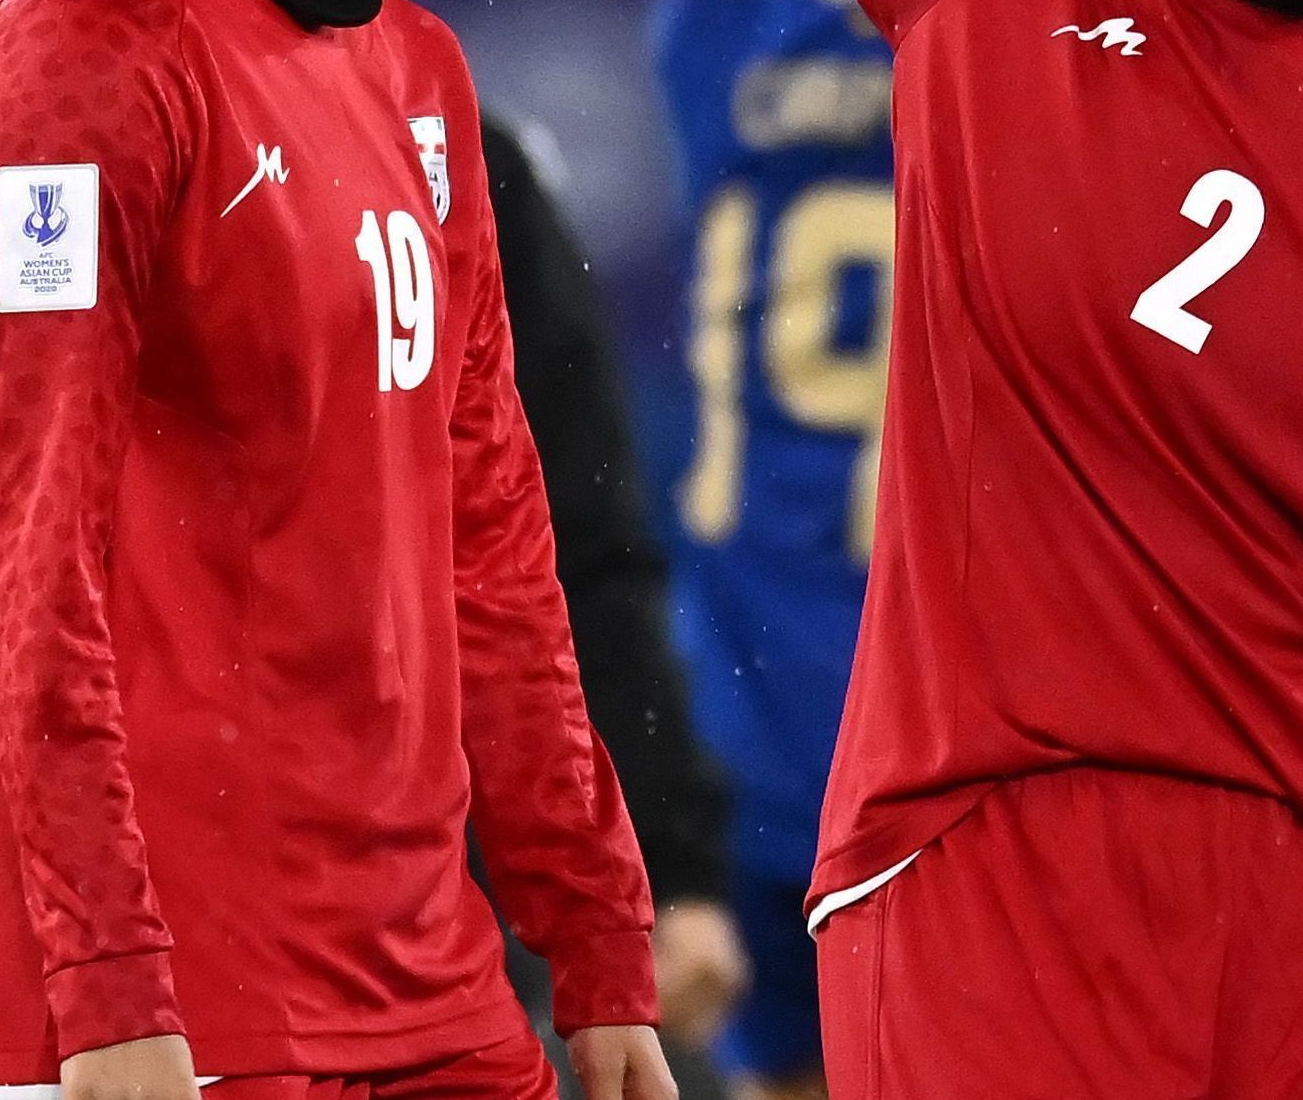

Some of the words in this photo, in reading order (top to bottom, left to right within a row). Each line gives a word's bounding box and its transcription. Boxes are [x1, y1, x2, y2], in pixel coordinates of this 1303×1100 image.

[23, 259, 69, 268] WOMEN'S
[1129, 168, 1266, 356] 2
[19, 268, 50, 277] ASIAN
[52, 267, 72, 276] CUP
[20, 277, 72, 285] AUSTRALIA
[354, 209, 436, 393] 19
